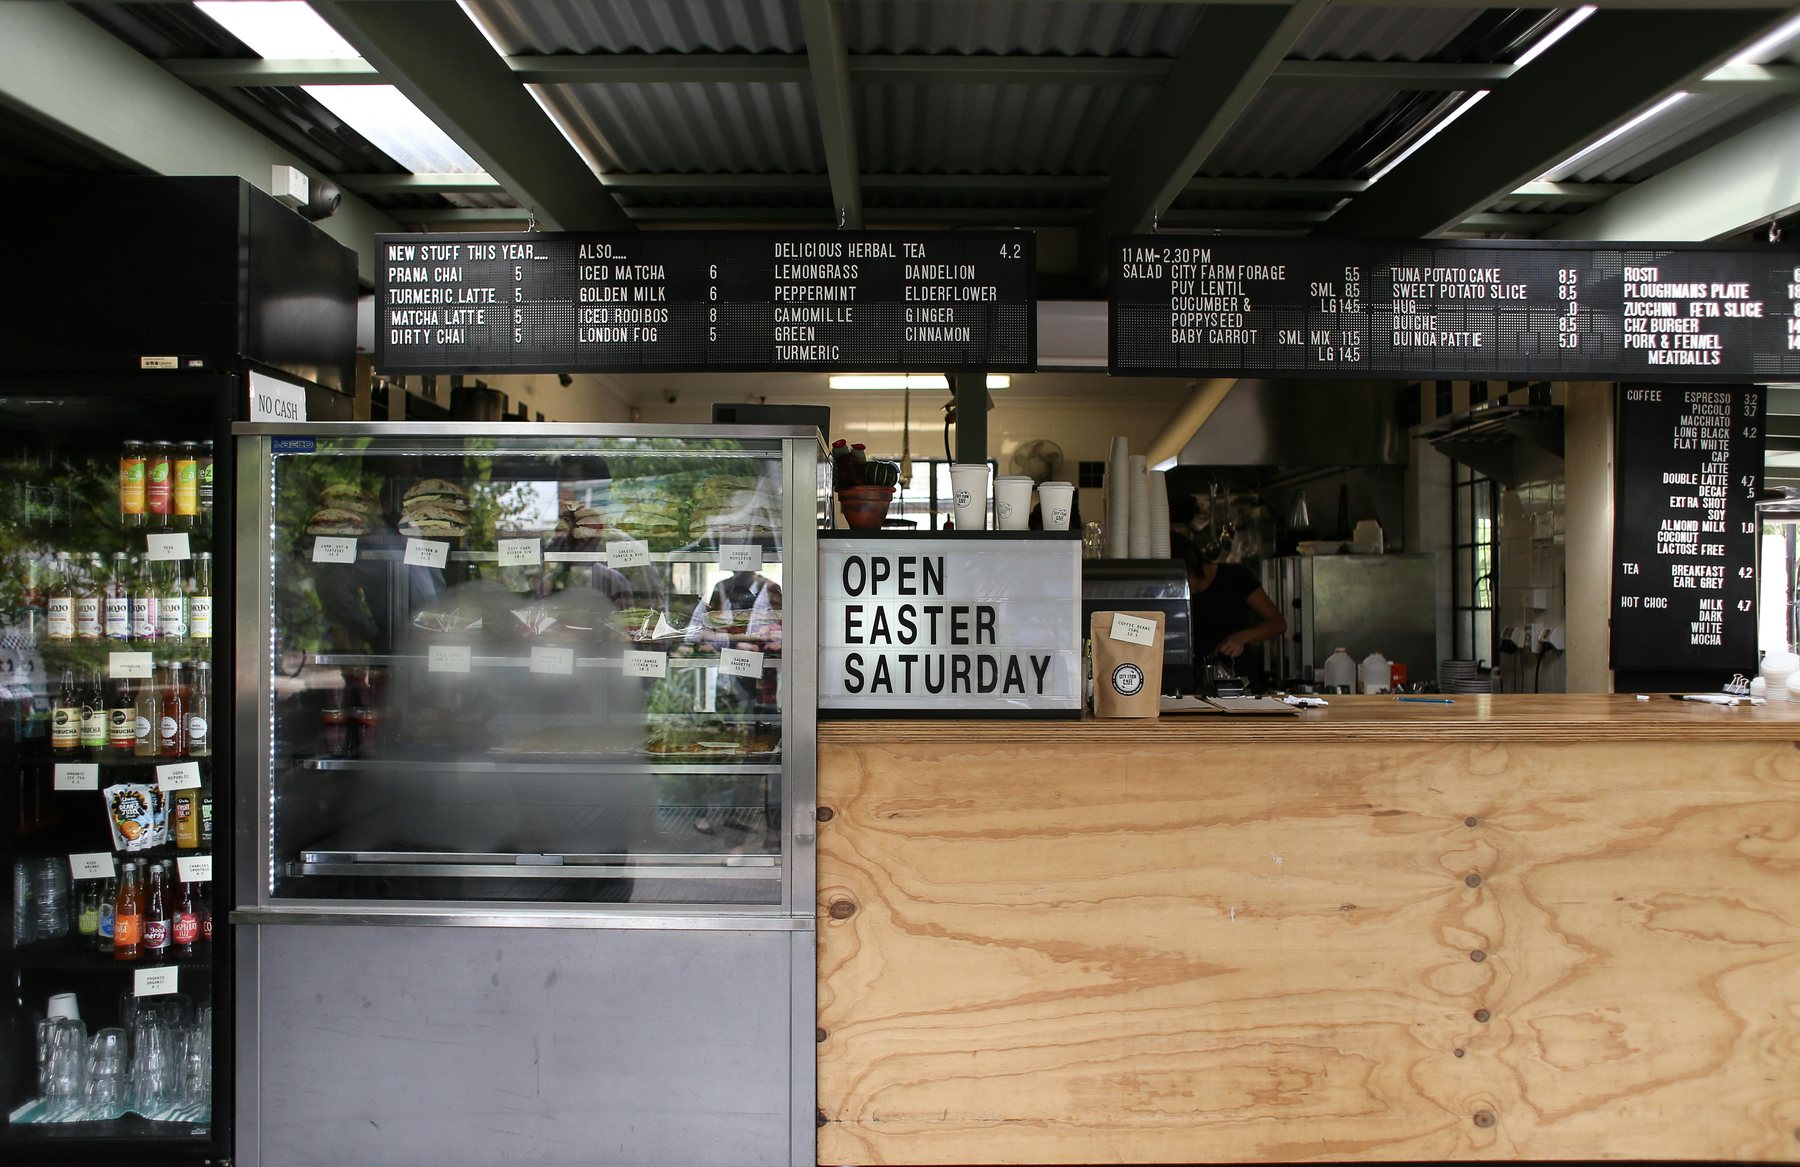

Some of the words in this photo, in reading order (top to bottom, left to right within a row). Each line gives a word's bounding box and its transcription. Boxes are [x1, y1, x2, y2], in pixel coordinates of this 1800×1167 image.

[388, 246, 415, 261] NEW
[421, 246, 459, 260] STUFF
[467, 245, 496, 260] THIS
[774, 242, 842, 258] DELICIOUS
[848, 242, 896, 258] HERBAL
[903, 243, 926, 258] TEA
[1000, 244, 1021, 259] 4.2
[388, 267, 428, 283] PRANA
[434, 267, 463, 282] CHAI
[515, 266, 522, 281] 5
[580, 266, 608, 281] ICED
[615, 265, 666, 280] MATCHA
[710, 264, 717, 280] 6
[774, 264, 858, 280] LEMONGRASS
[905, 264, 975, 280] DANDELION
[1123, 264, 1162, 279] SALAD
[1171, 264, 1197, 280] CITY
[1201, 265, 1235, 280] FARM
[1238, 265, 1286, 280] FORAGE
[1344, 266, 1360, 281] 5.5
[1391, 267, 1420, 283] TUNA
[1424, 268, 1466, 283] POTATO
[1469, 268, 1500, 283] CAKE
[1558, 269, 1577, 285] 8.5
[1624, 266, 1658, 282] ROSTI
[390, 288, 453, 304] TURMERIC
[458, 288, 496, 303] LATTE
[515, 288, 522, 303] 5
[580, 287, 628, 302] GOLDEN
[634, 287, 666, 302] MILK
[710, 286, 717, 301] 6
[774, 286, 856, 301] PEPPERMINT
[905, 286, 997, 302] ELDERFLOWER
[1171, 281, 1194, 296] PUY
[1201, 281, 1246, 296] LENTIL
[1310, 282, 1336, 297] SML
[1344, 282, 1360, 298] 8.5
[1392, 284, 1435, 299] SWEET
[1440, 284, 1485, 299] POTATO
[1490, 284, 1527, 300] SLICE
[1558, 285, 1577, 301] 8.5
[1624, 283, 1708, 299] PLOUGHMANS
[1710, 284, 1750, 299] PLATE
[1171, 297, 1238, 312] CUCUMBER
[1243, 298, 1251, 312] &
[1321, 298, 1336, 313] LG
[1339, 298, 1360, 314] 14.5
[1392, 300, 1416, 315] HUG
[1624, 302, 1678, 317] ZUCCHINI
[1690, 302, 1720, 318] FETA
[1724, 302, 1764, 318] SLICE
[392, 310, 438, 326] MATCHA
[445, 310, 485, 325] LATTE
[515, 310, 522, 324] 5
[580, 309, 608, 324] ICED
[614, 308, 668, 324] ROOIBOS
[710, 308, 717, 322] 8
[905, 308, 954, 323] GINGER
[1171, 313, 1243, 328] POPPYSEED
[1393, 315, 1438, 331] QUICHE
[1559, 316, 1577, 332] 8.5
[1624, 318, 1648, 333] CHZ
[1650, 318, 1700, 334] BURGER
[391, 329, 430, 345] DIRTY
[436, 329, 465, 344] CHAI
[515, 328, 522, 344] 5
[580, 328, 628, 343] LONDON
[634, 328, 658, 342] FOG
[710, 327, 717, 342] 5
[774, 327, 816, 342] GREEN
[905, 327, 970, 342] CINNAMON
[1171, 329, 1202, 344] BABY
[1209, 329, 1258, 344] CARROT
[1278, 330, 1304, 344] SML
[1310, 330, 1330, 345] MIX
[1342, 330, 1360, 346] 11.5
[1393, 332, 1437, 347] QUINOA
[1440, 332, 1482, 347] PATTIE
[1559, 333, 1577, 348] 5.0
[1624, 334, 1656, 349] PORK
[1660, 334, 1670, 348] &
[1674, 334, 1723, 350] FENNEL
[775, 346, 840, 360] TURMERIC
[1318, 346, 1334, 362] LG
[1339, 346, 1360, 362] 14.5
[1648, 350, 1721, 366] MEATBALLS
[1627, 390, 1662, 402] COFFEE
[1684, 392, 1731, 404] ESPRESSO
[258, 394, 272, 414] NO
[274, 398, 298, 420] CASH
[1692, 404, 1730, 416] PICCOLO
[1680, 415, 1730, 428] MACCHIATO
[1674, 426, 1698, 438] LONG
[1700, 428, 1730, 439] BLACK
[1674, 438, 1697, 450] FLAT
[1700, 440, 1729, 450] WHITE
[1712, 452, 1729, 462] CAP
[1702, 462, 1728, 474] LATTE
[1663, 472, 1698, 484] DOUBLE
[1701, 474, 1728, 486] LATTE
[1698, 486, 1728, 498] DECAF
[1670, 496, 1698, 508] EXTRA
[1702, 498, 1727, 509] SHOT
[1708, 510, 1726, 520] SOY
[1660, 520, 1698, 532] ALMOND
[1702, 521, 1726, 532] MILK
[1657, 532, 1699, 544] COCONUT
[1656, 543, 1698, 555] LACTOSE
[1701, 544, 1725, 556] FREE
[842, 555, 944, 597] OPEN
[1622, 563, 1639, 574] TEA
[1672, 564, 1725, 577] BREAKFAST
[1674, 576, 1697, 588] EARL
[1700, 578, 1724, 588] GREY
[1621, 596, 1640, 608] HOT
[1644, 597, 1668, 608] CHOC
[1700, 599, 1724, 610] MILK
[1118, 620, 1135, 628] COFFEE
[1699, 610, 1722, 622] DARK
[845, 604, 996, 645] EASTER
[1691, 622, 1722, 634] WHITE
[1691, 634, 1722, 646] MOCHA
[844, 652, 1052, 694] SATURDAY
